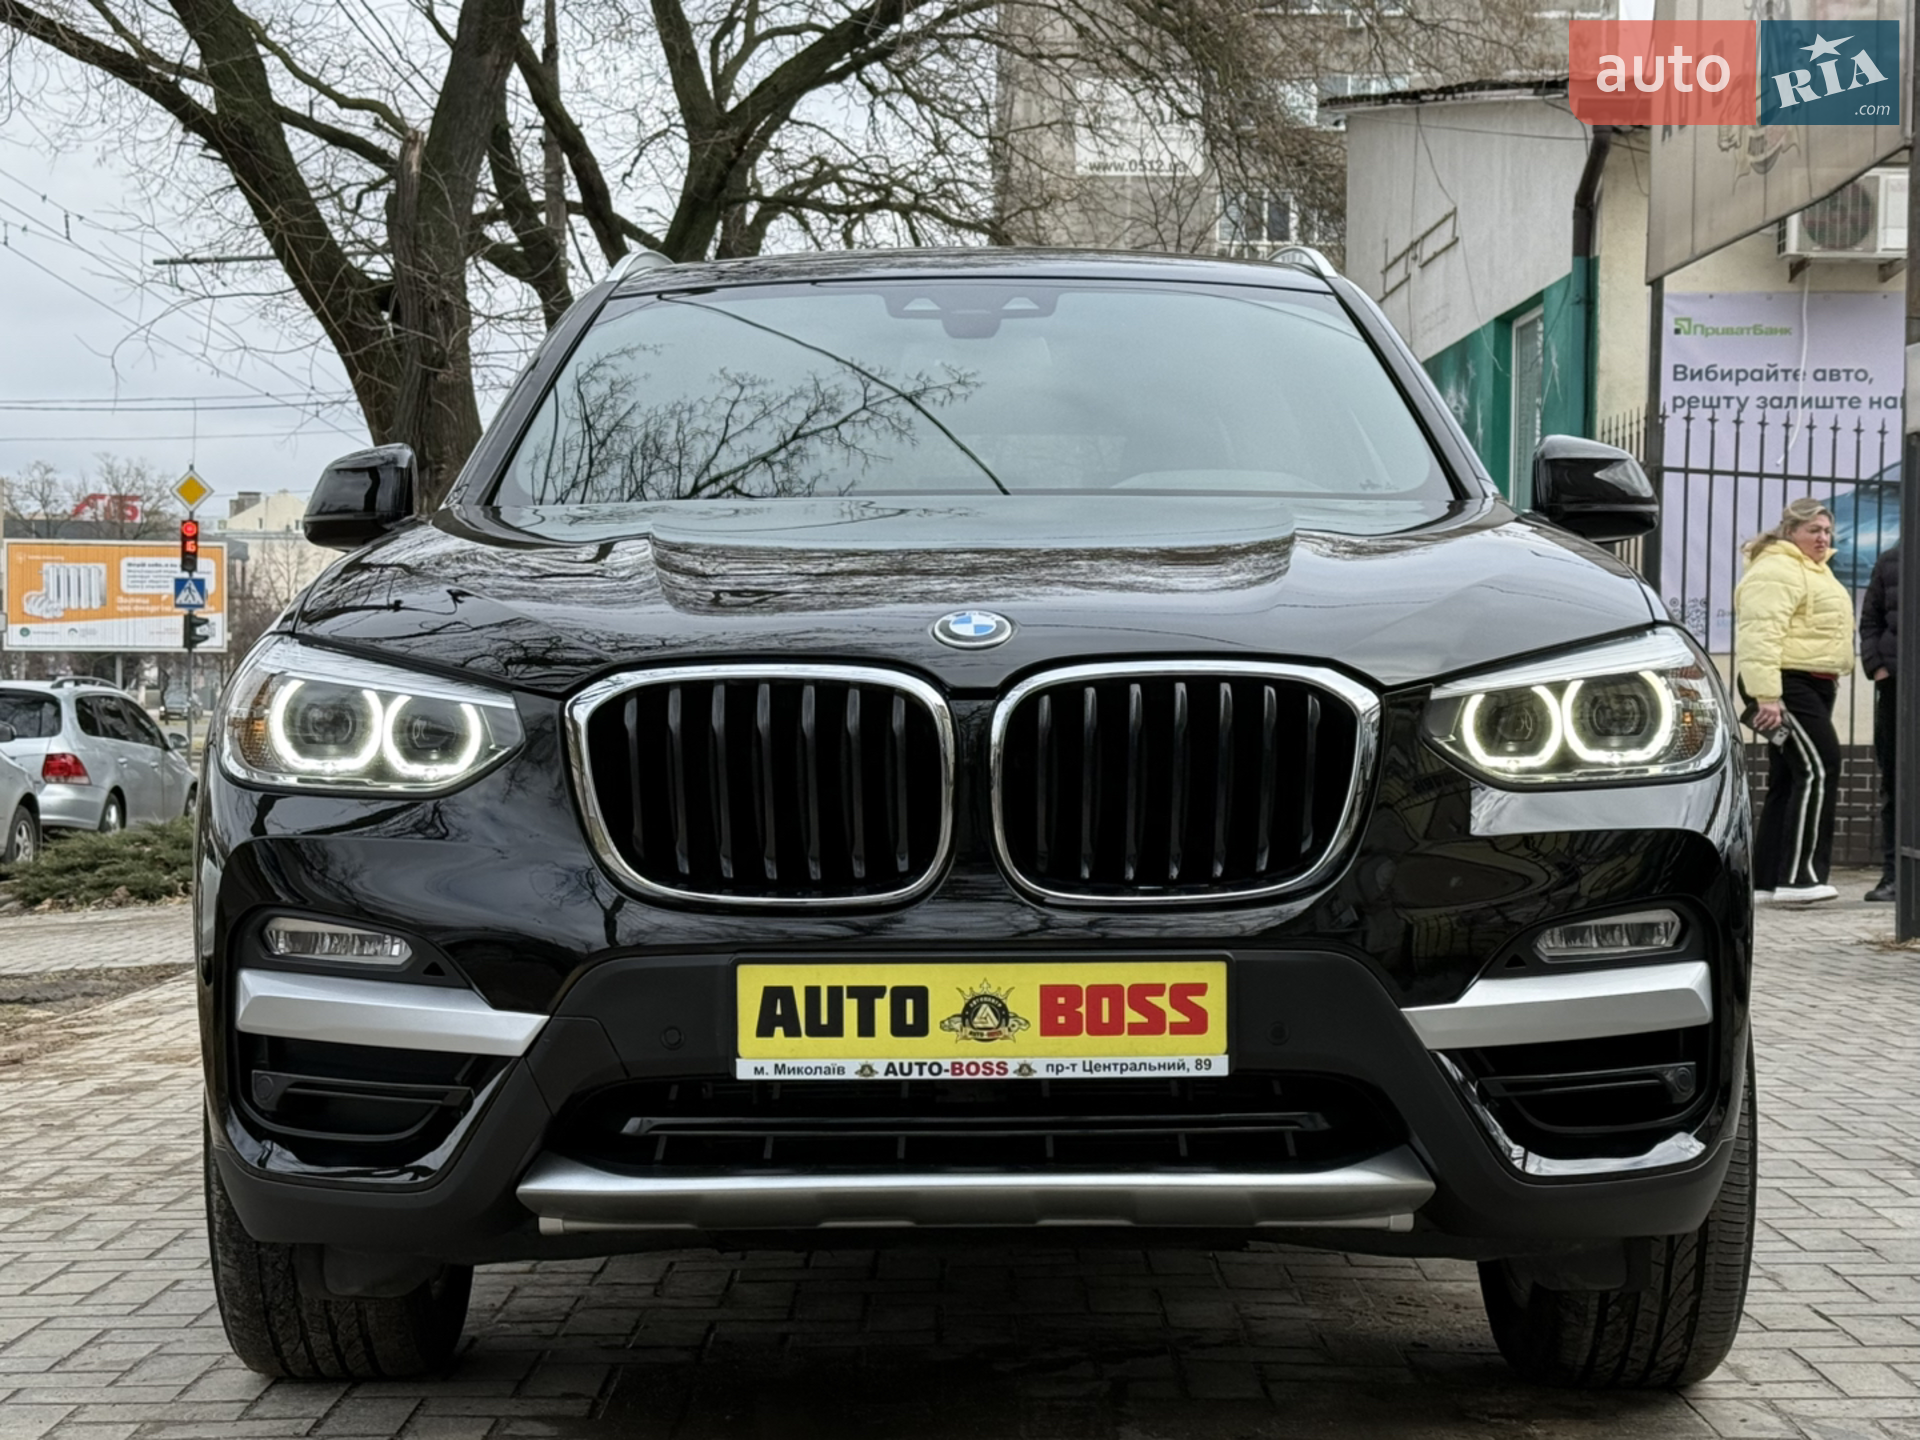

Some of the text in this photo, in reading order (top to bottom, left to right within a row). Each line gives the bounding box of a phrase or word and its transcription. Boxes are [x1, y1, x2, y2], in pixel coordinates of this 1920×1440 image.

[1692, 323, 1793, 338] ПриватБанк
[1672, 362, 1874, 387] Вибирайте авто,
[1672, 395, 1750, 413] решту
[1756, 395, 1862, 410] залиште
[755, 982, 1209, 1038] AUTO BOSS
[753, 1063, 846, 1077] м. Миколаїв
[883, 1060, 1009, 1077] AUTO-BOSS
[1045, 1057, 1213, 1076] пр-т Центральний, 89
